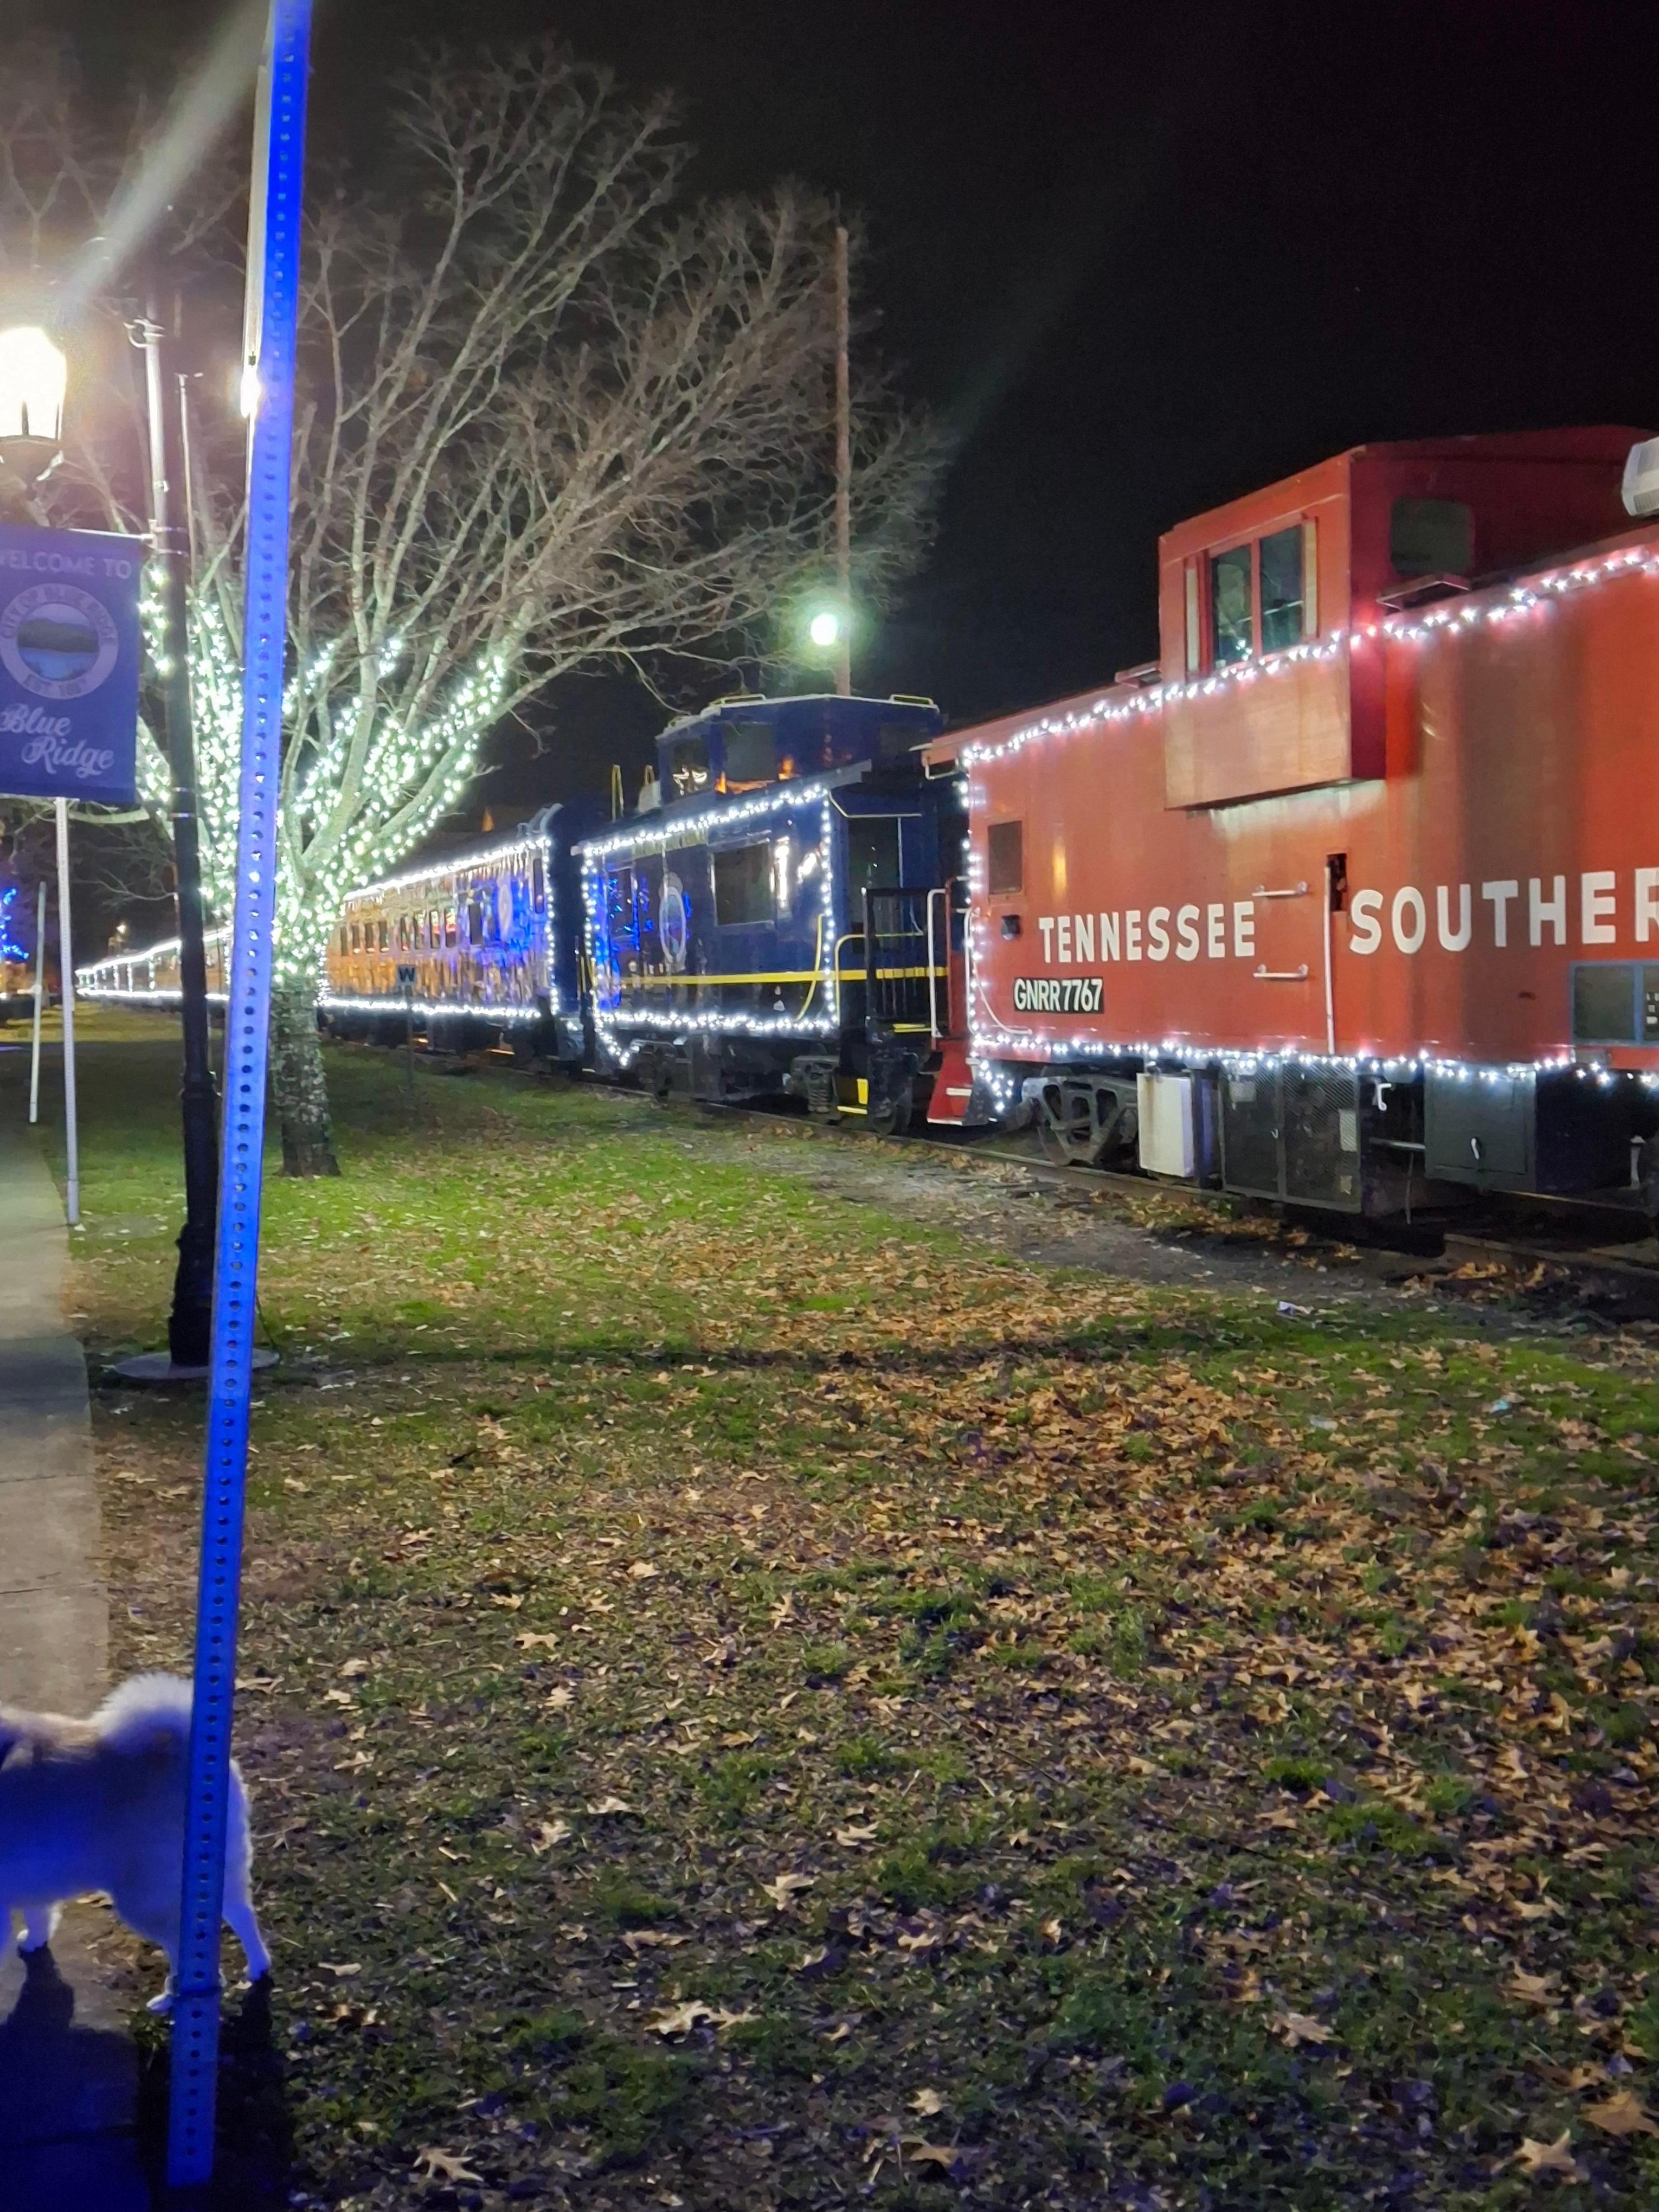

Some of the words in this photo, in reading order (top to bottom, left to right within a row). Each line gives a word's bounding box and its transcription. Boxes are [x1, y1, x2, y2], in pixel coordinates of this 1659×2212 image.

[0, 549, 95, 575] ELCOME
[103, 558, 132, 580] TO
[0, 703, 71, 737] Blue
[22, 736, 115, 779] Ridge
[1349, 867, 1659, 954] SOUTHER
[1039, 901, 1255, 962] TENNESSEE
[399, 967, 415, 982] W
